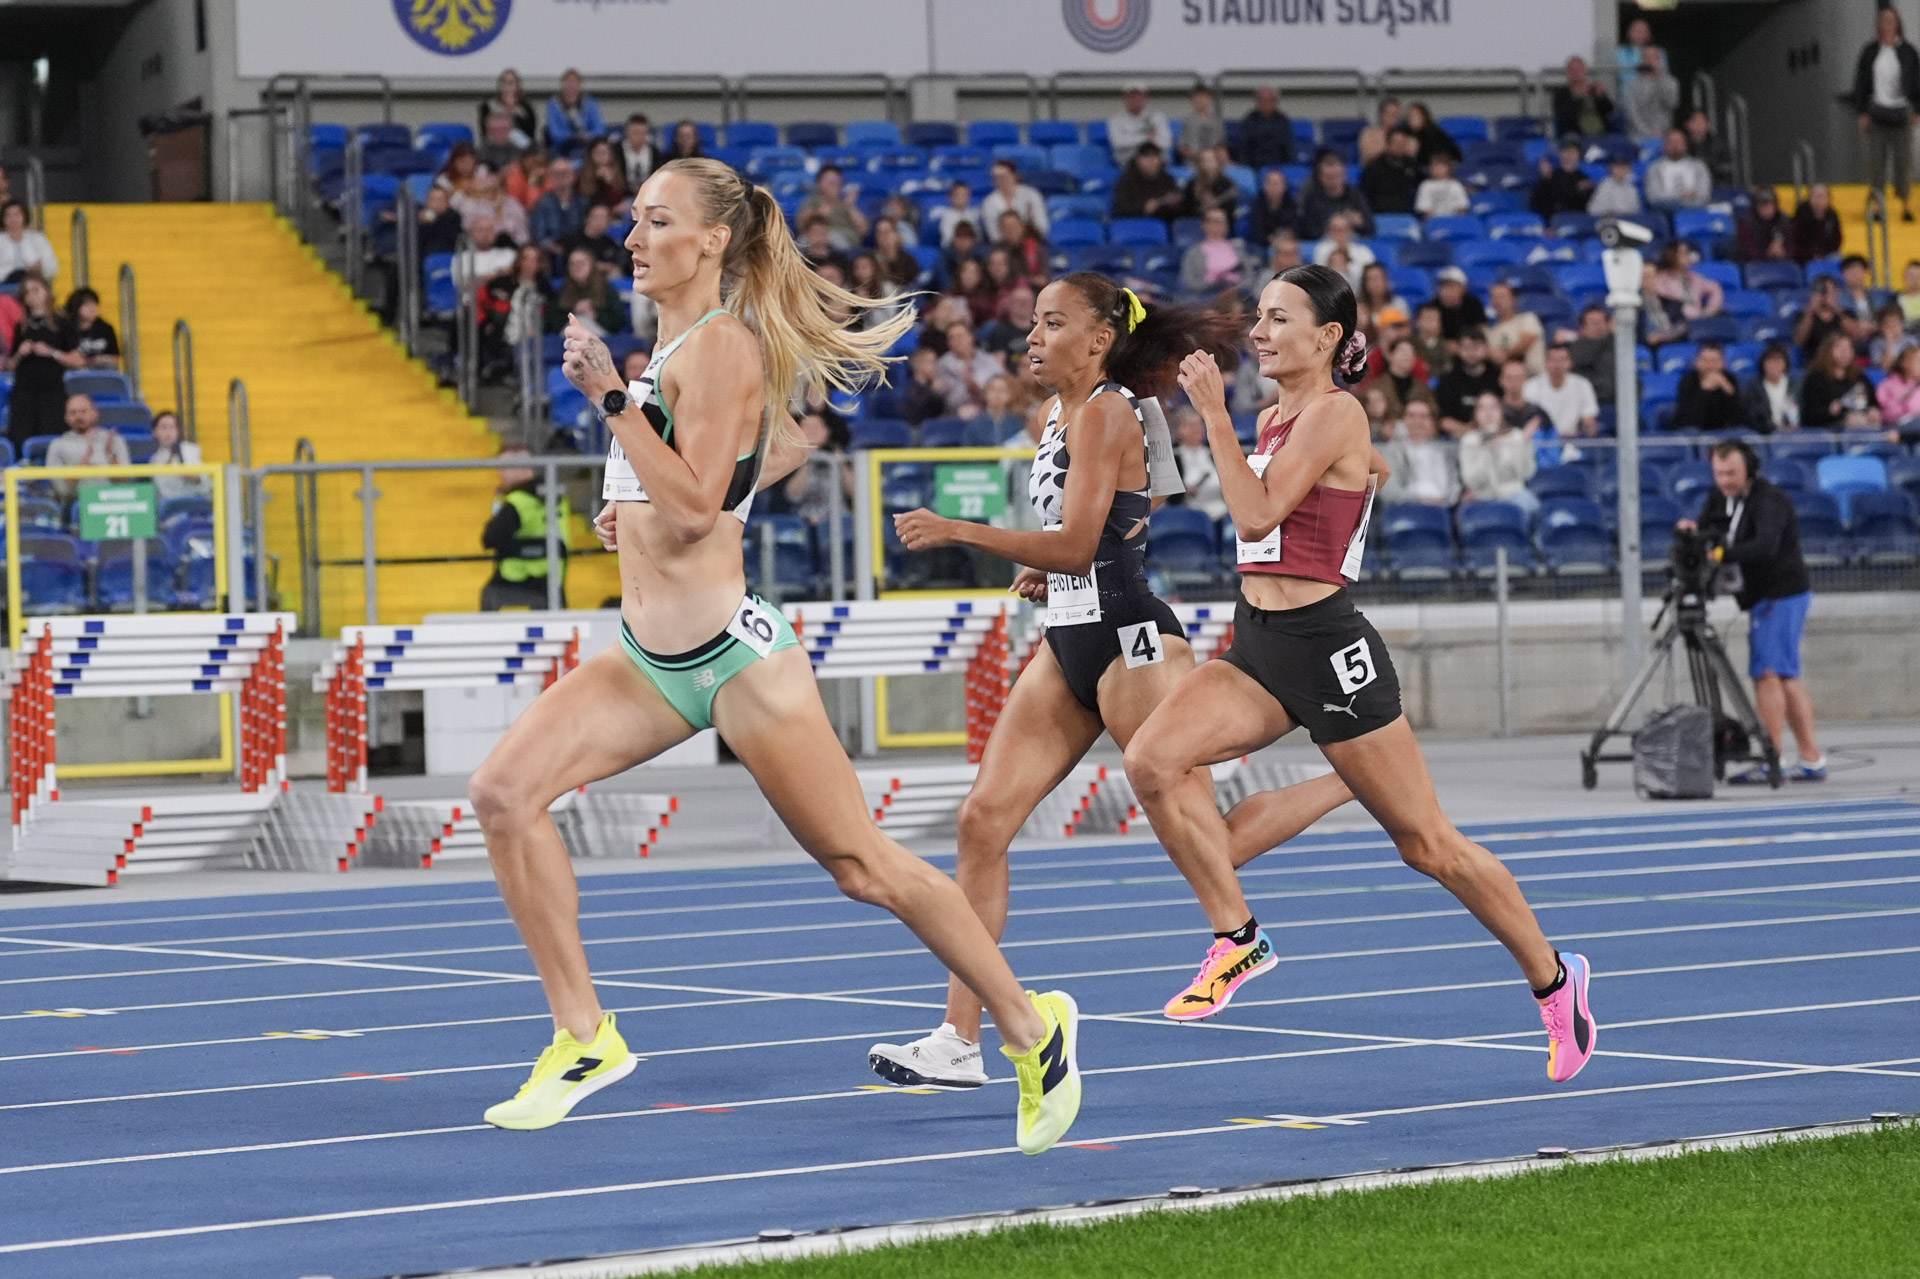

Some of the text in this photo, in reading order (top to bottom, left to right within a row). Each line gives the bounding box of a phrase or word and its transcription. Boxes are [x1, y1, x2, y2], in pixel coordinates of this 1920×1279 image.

[105, 515, 129, 538] 21
[740, 609, 773, 643] 6
[1131, 626, 1156, 661] 4
[1343, 646, 1368, 684] 5
[1215, 939, 1270, 987] NITRO
